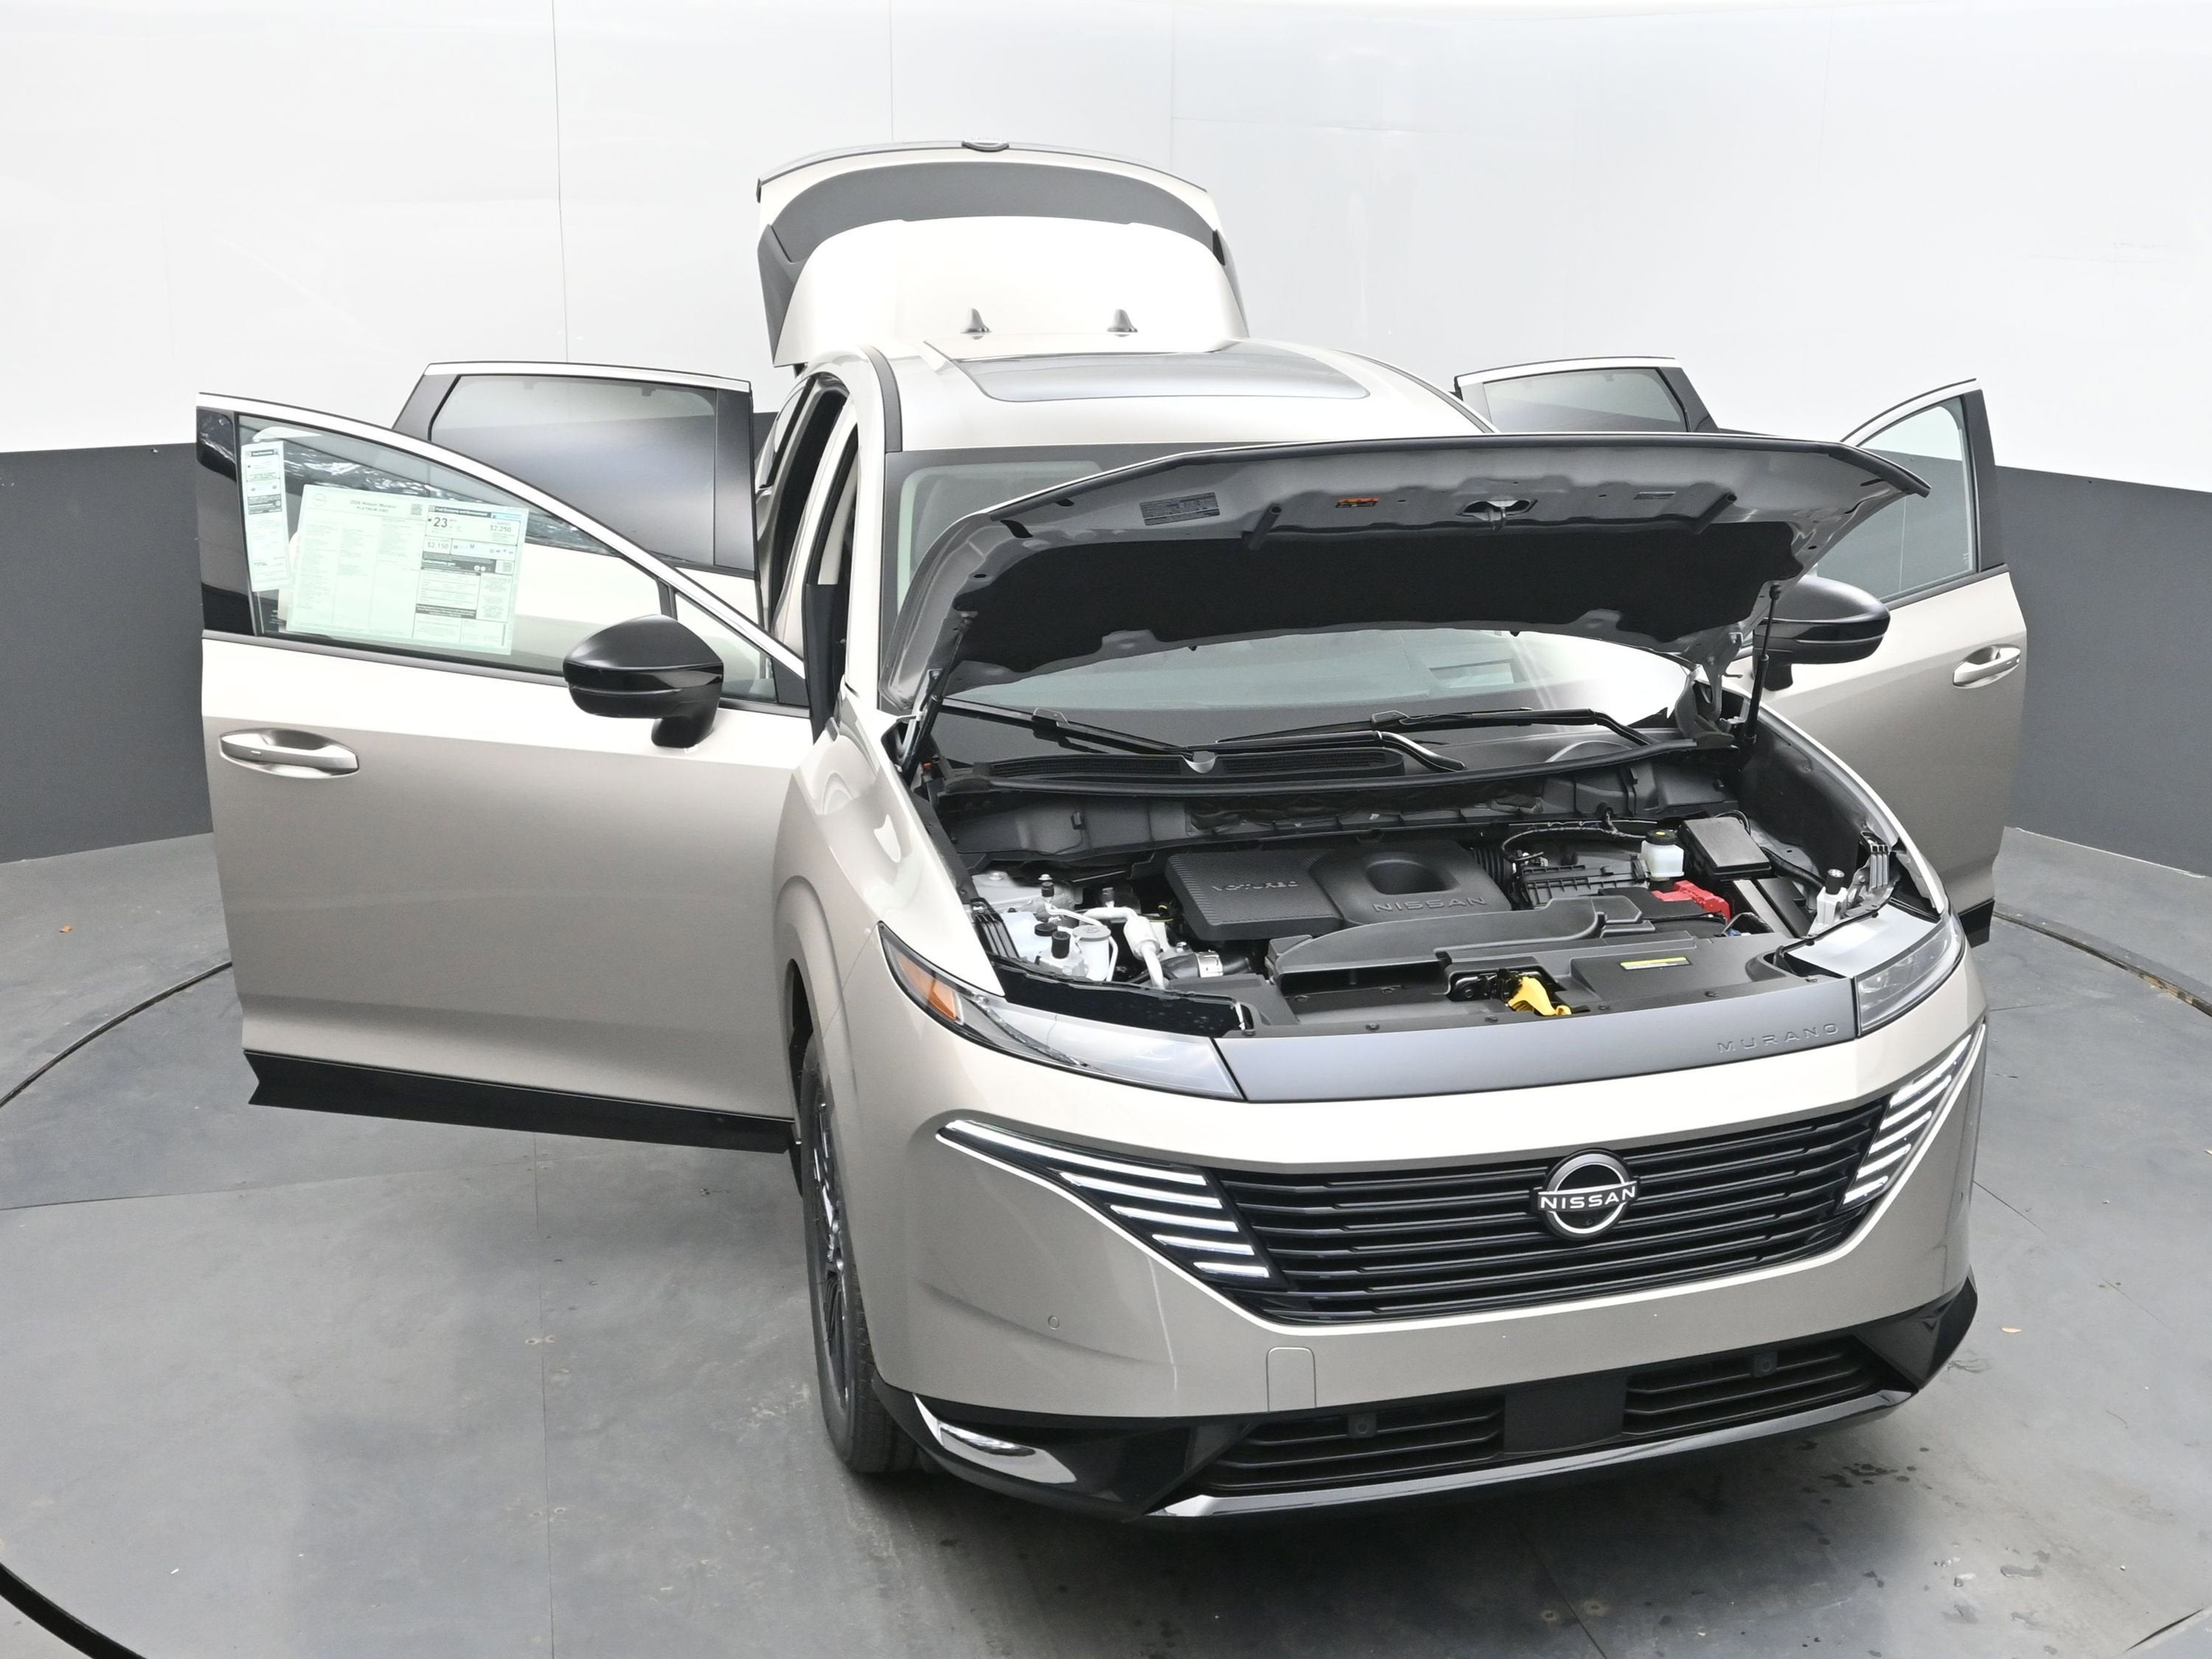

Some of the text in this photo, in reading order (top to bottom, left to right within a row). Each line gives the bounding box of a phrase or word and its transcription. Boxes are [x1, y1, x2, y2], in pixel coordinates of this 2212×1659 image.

[434, 517, 448, 528] 23
[1372, 896, 1487, 912] NISSAN
[1717, 1023, 1839, 1054] MURANO
[1540, 1185, 1636, 1210] NISSAN
